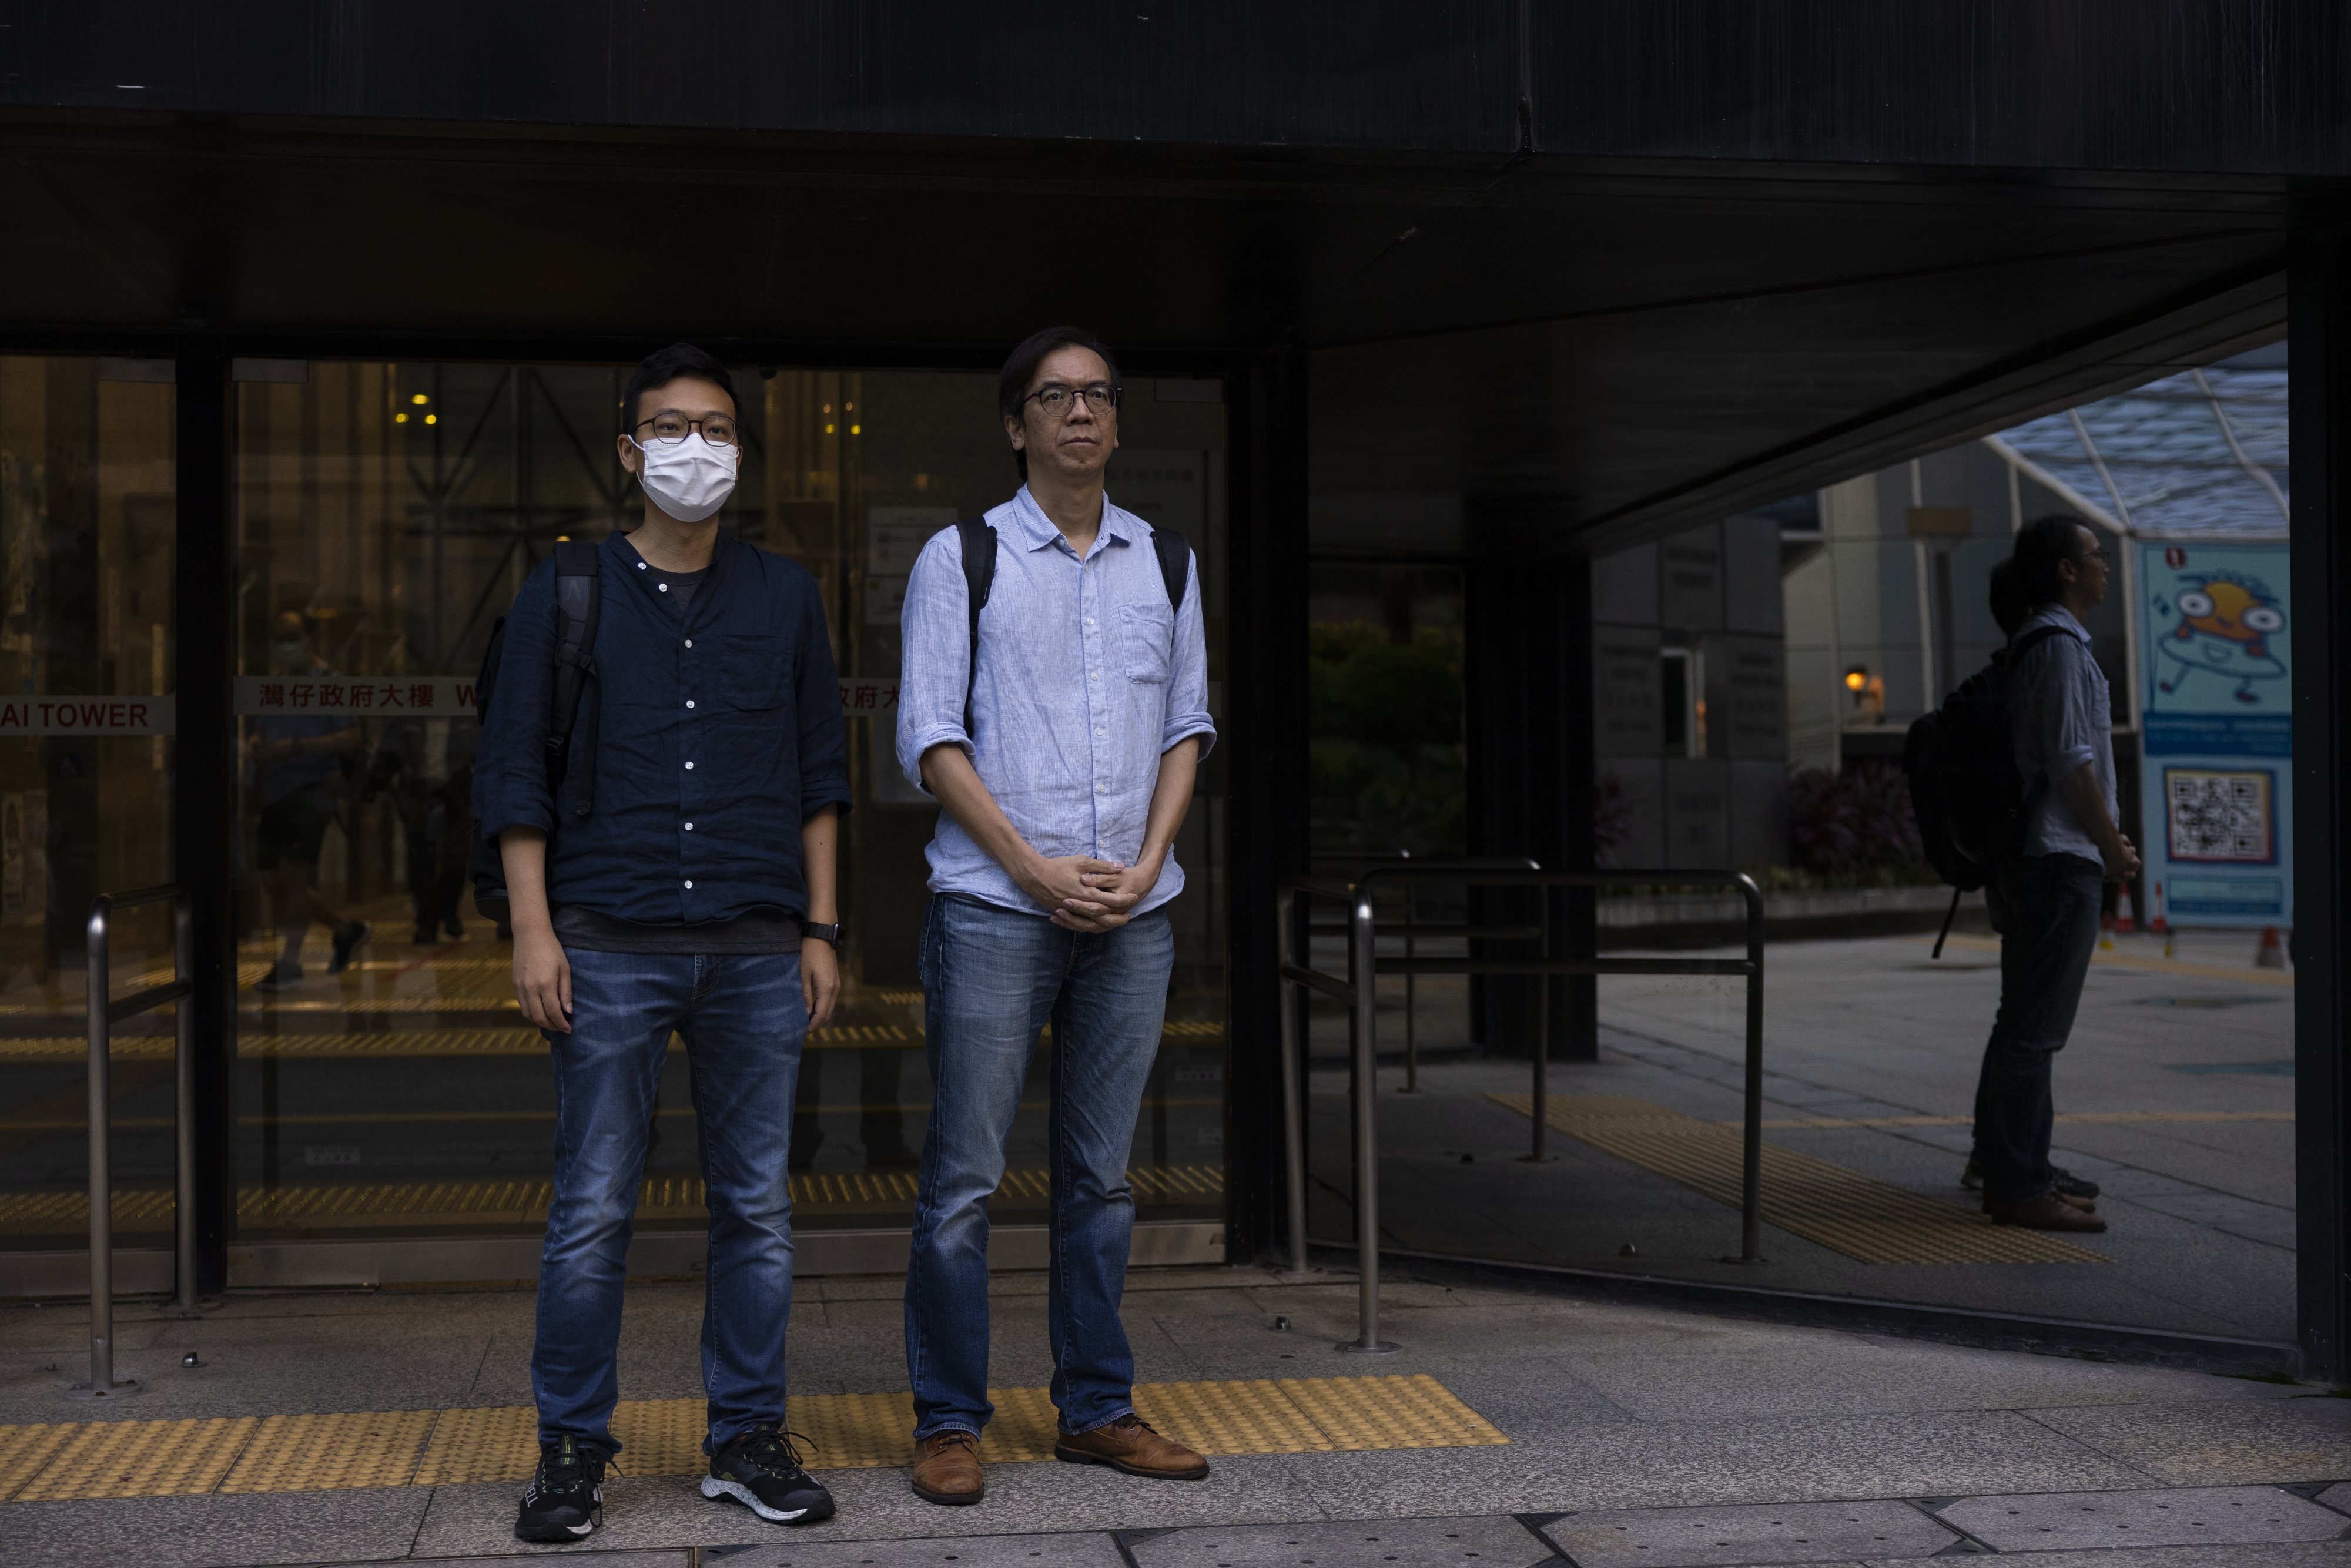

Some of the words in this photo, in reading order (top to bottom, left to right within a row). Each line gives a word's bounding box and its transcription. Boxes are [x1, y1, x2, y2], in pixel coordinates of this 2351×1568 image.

[259, 684, 434, 708] 灣仔政府大樓
[38, 703, 148, 727] TOWER
